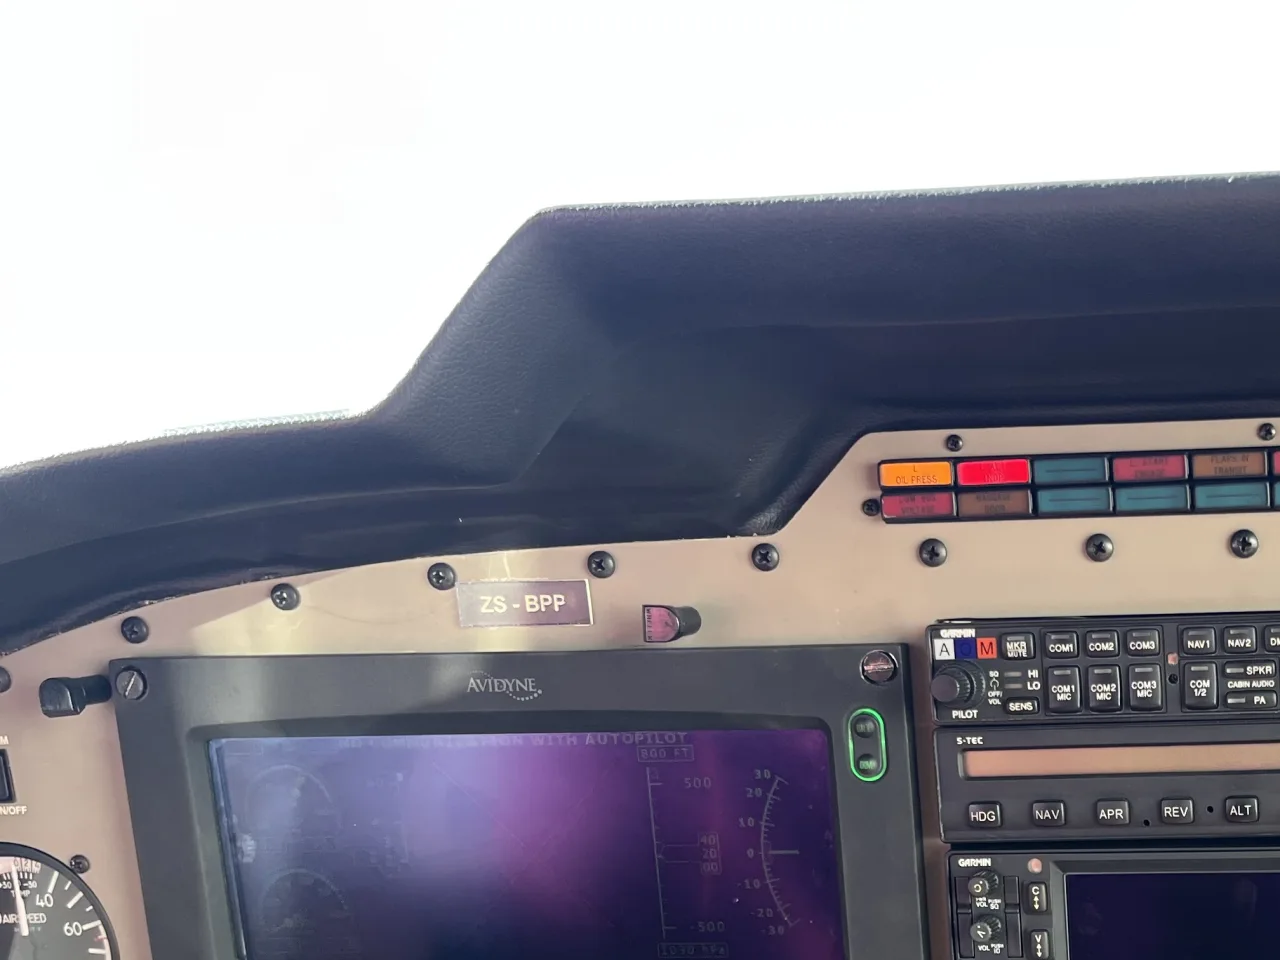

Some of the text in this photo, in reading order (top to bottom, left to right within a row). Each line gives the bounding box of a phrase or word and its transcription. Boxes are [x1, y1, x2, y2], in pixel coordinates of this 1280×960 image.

[896, 475, 939, 485] OIL PRESS
[480, 596, 507, 613] ZS
[524, 594, 565, 612] BPP
[1089, 642, 1115, 651] COM2
[1130, 640, 1156, 650] COM3
[1188, 640, 1209, 648] NAV1
[1228, 638, 1251, 647] NAV2
[1049, 644, 1073, 652] COM1
[1247, 665, 1273, 675] SPKR
[466, 676, 537, 693] AVIDYNE
[1254, 696, 1266, 704] PA
[1009, 702, 1033, 711] SENS
[952, 710, 978, 718] PILOT
[970, 808, 996, 821] HDG
[1034, 807, 1061, 819] NAV
[1100, 808, 1123, 819] APR
[1164, 806, 1188, 817] REV
[1230, 805, 1251, 815] ALT
